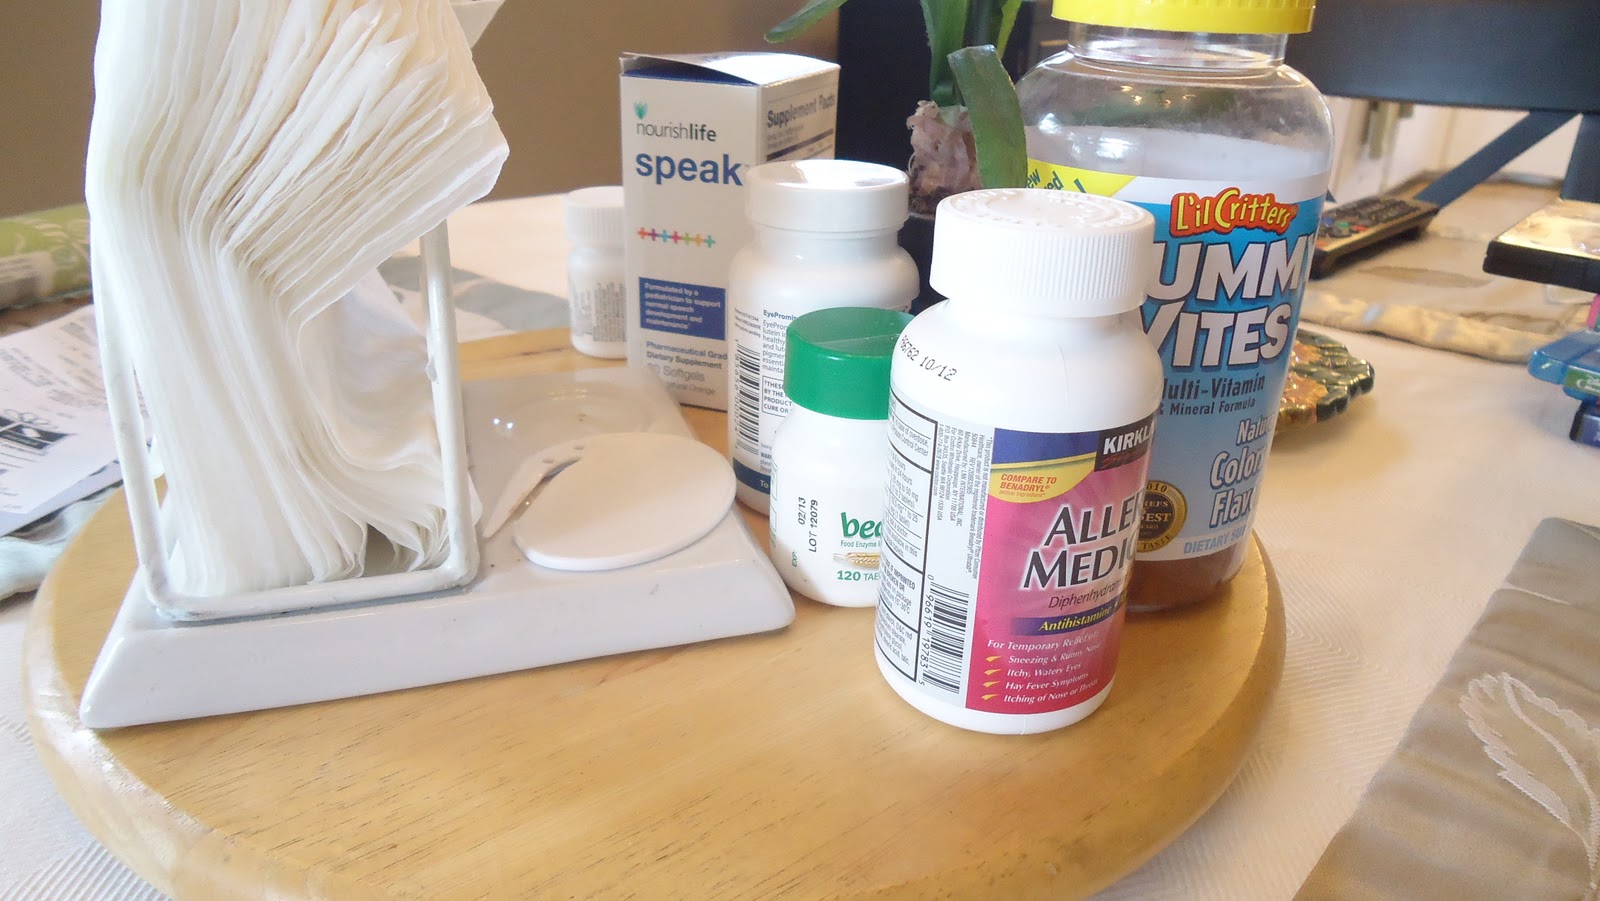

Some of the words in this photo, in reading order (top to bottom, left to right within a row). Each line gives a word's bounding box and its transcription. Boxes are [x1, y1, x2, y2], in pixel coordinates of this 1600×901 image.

[767, 98, 817, 128] Supplement
[637, 121, 717, 142] nourishlife
[636, 153, 743, 186] speak
[1177, 194, 1210, 231] L'il
[1213, 187, 1292, 230] Critters
[1147, 233, 1313, 301] UMM
[646, 340, 706, 357] Pharmaceutical
[708, 350, 728, 360] Grad
[646, 350, 674, 363] Dietary
[675, 356, 722, 370] Supplement
[663, 365, 705, 382] Softgels
[920, 356, 958, 381] 10/12
[1162, 373, 1266, 400] ulti-Vitamin
[764, 396, 792, 406] PRODUCT
[764, 404, 780, 412] CURE
[1169, 401, 1215, 416] Mineral
[1218, 398, 1256, 413] Formula
[1000, 473, 1044, 484] COMPARE
[1046, 476, 1057, 484] TO
[798, 496, 806, 525] 02/13
[810, 500, 818, 528] 12079
[808, 531, 818, 552] LOT
[856, 540, 877, 548] Enzyme
[1183, 535, 1230, 555] DIETARY
[837, 570, 860, 581] 120
[922, 594, 935, 629] 96619
[1038, 606, 1112, 632] Antihistamine
[920, 637, 931, 669] 19783
[987, 639, 1006, 649] For
[1008, 640, 1060, 652] Temporary
[1008, 656, 1048, 665] Sneezing
[1005, 682, 1024, 690] Hay
[1026, 682, 1050, 690] Fever
[1050, 672, 1089, 688] Symptoms
[1006, 668, 1031, 679] Itchy,
[1034, 668, 1064, 676] Watery
[1066, 663, 1082, 674] Eyes
[1004, 694, 1035, 704] Itching
[1048, 692, 1068, 700] Nose
[1069, 688, 1078, 696] or
